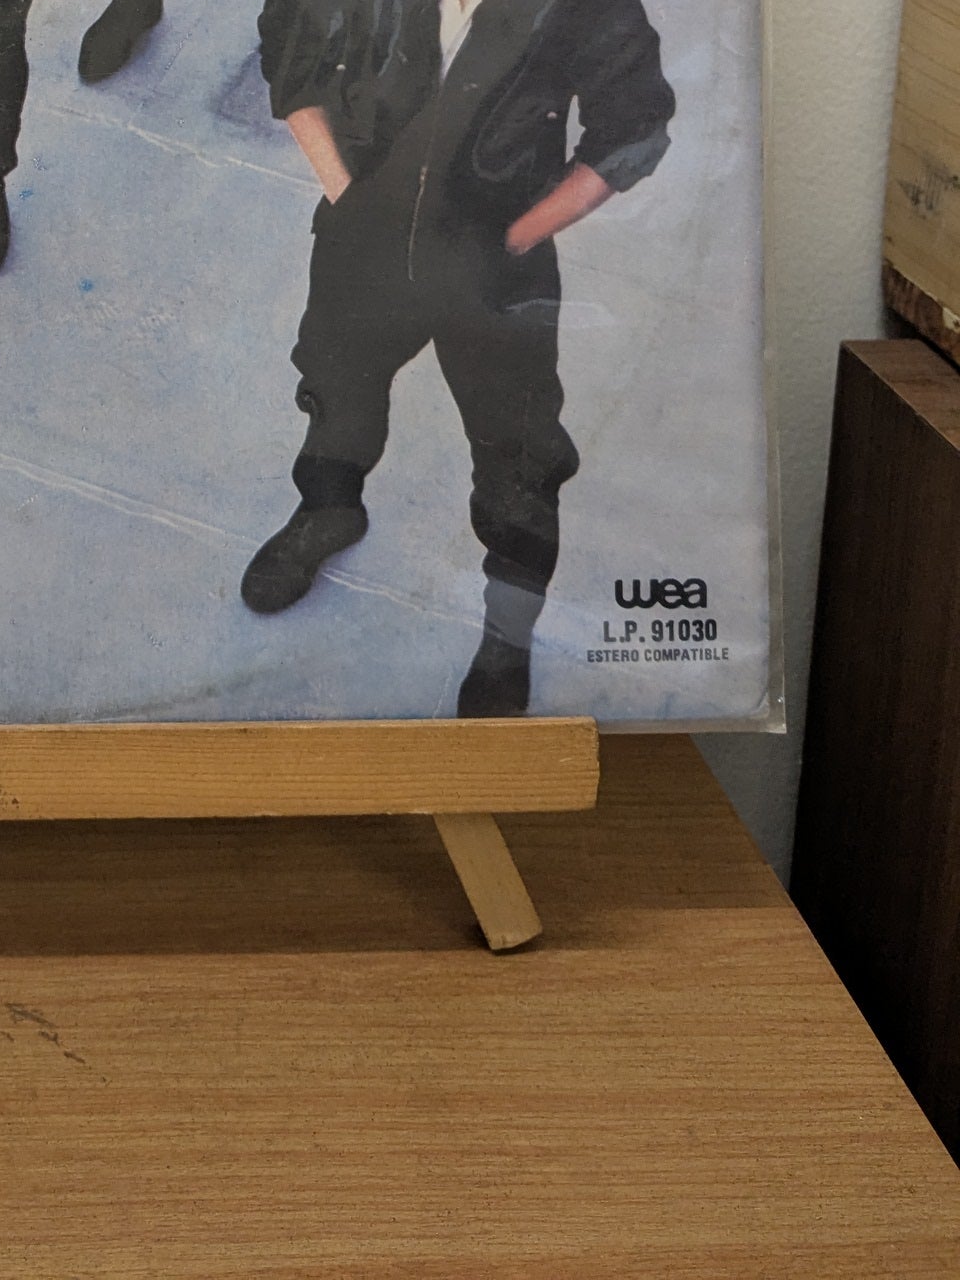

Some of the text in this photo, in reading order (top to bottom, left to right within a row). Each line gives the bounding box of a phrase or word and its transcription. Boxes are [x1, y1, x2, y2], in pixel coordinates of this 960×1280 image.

[614, 577, 708, 609] wea
[603, 619, 717, 643] L.P. 91030
[586, 647, 729, 663] ESTERO COMPATIBLE
